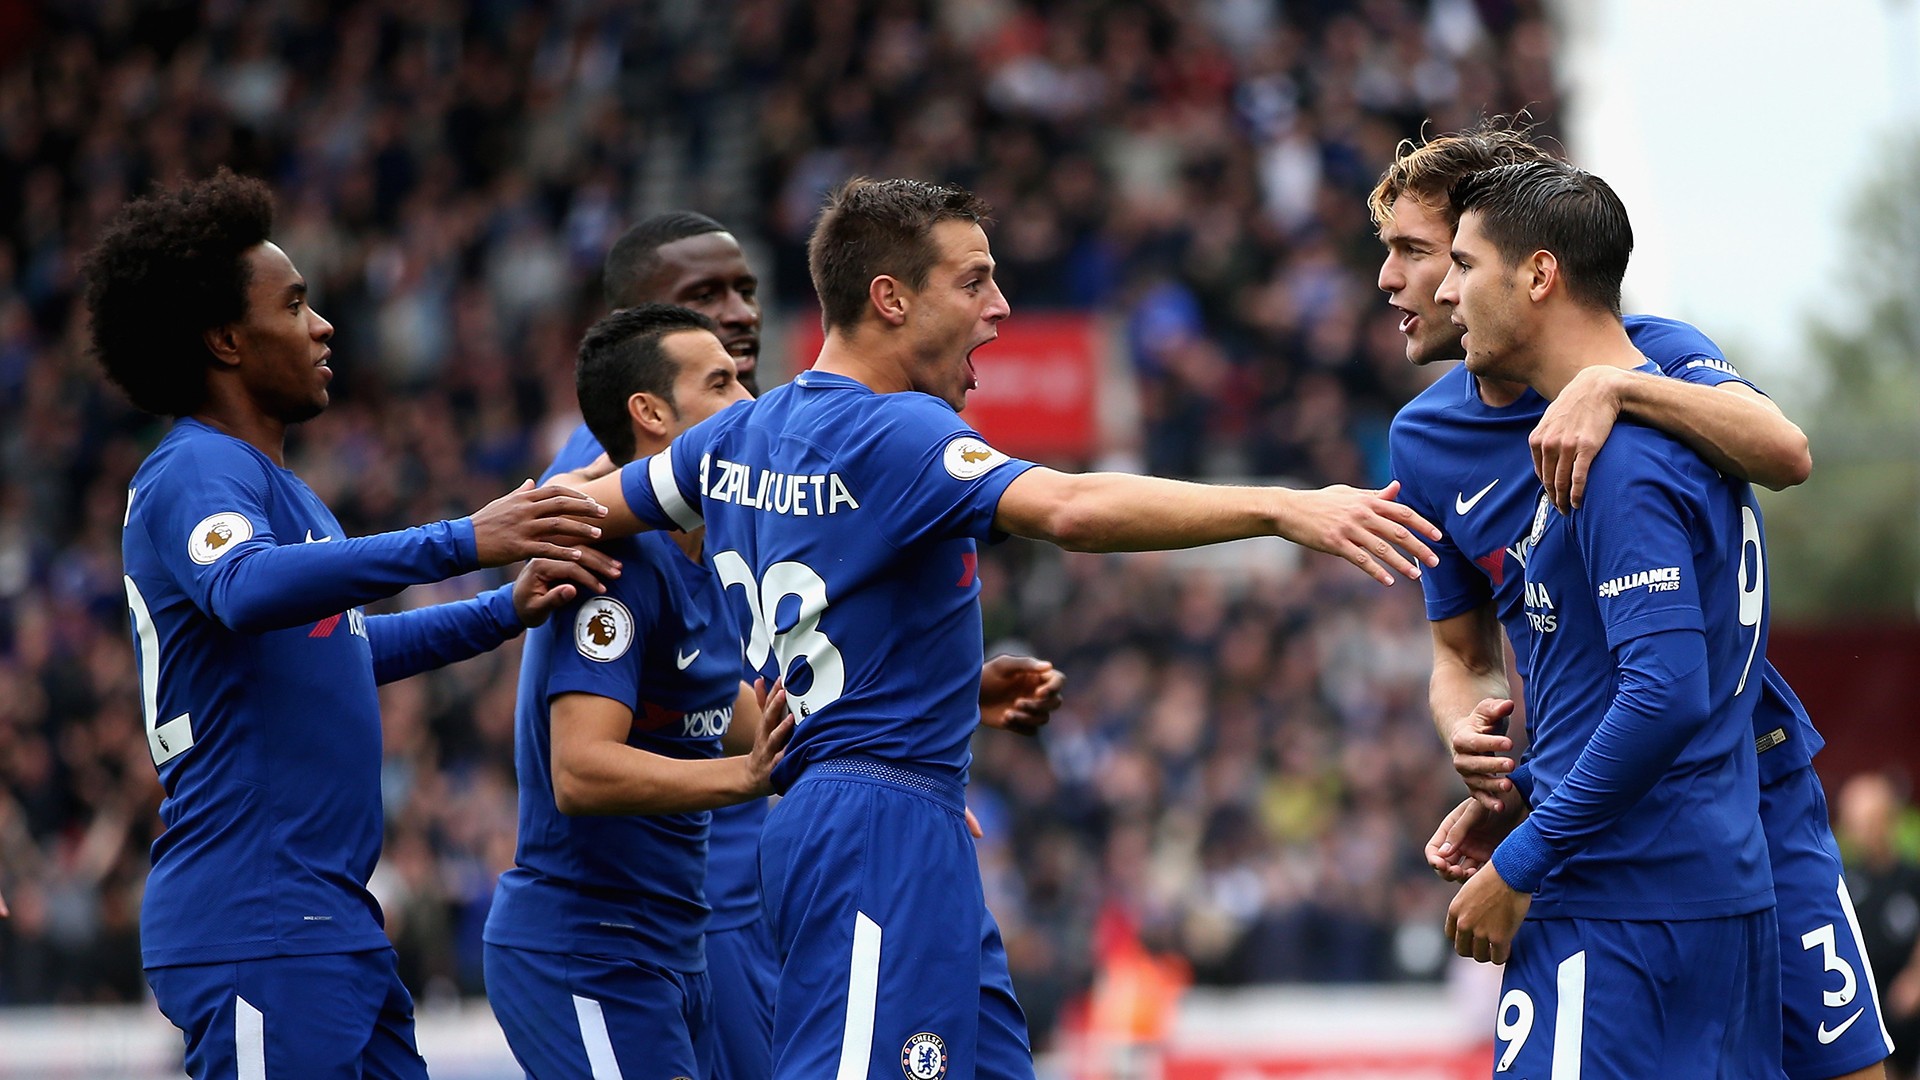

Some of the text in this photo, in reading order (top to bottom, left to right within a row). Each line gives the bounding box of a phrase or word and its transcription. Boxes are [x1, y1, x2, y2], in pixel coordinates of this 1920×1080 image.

[1607, 567, 1680, 598] ALLIANCE
[1648, 581, 1680, 593] TYRES
[1734, 505, 1764, 697] 9
[1801, 923, 1857, 1007] 3
[911, 1034, 943, 1050] CHELSEA
[1495, 988, 1535, 1074] 9
